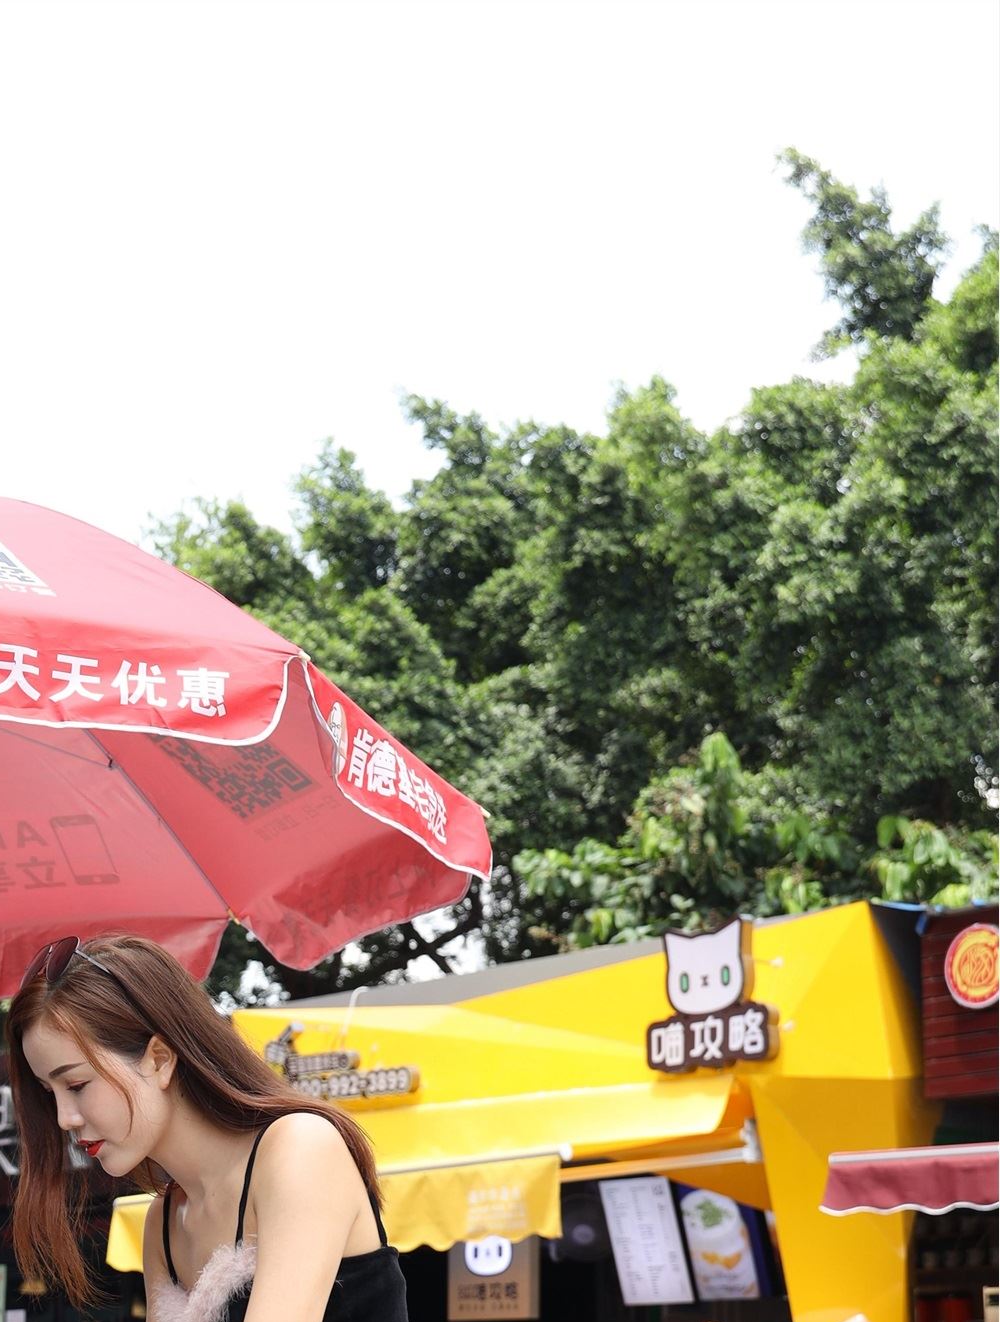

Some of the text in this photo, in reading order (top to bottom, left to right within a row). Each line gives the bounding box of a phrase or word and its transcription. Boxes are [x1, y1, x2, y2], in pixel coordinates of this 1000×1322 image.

[650, 1008, 764, 1067] 喵攻略
[292, 1067, 411, 1098] 00-992-3899
